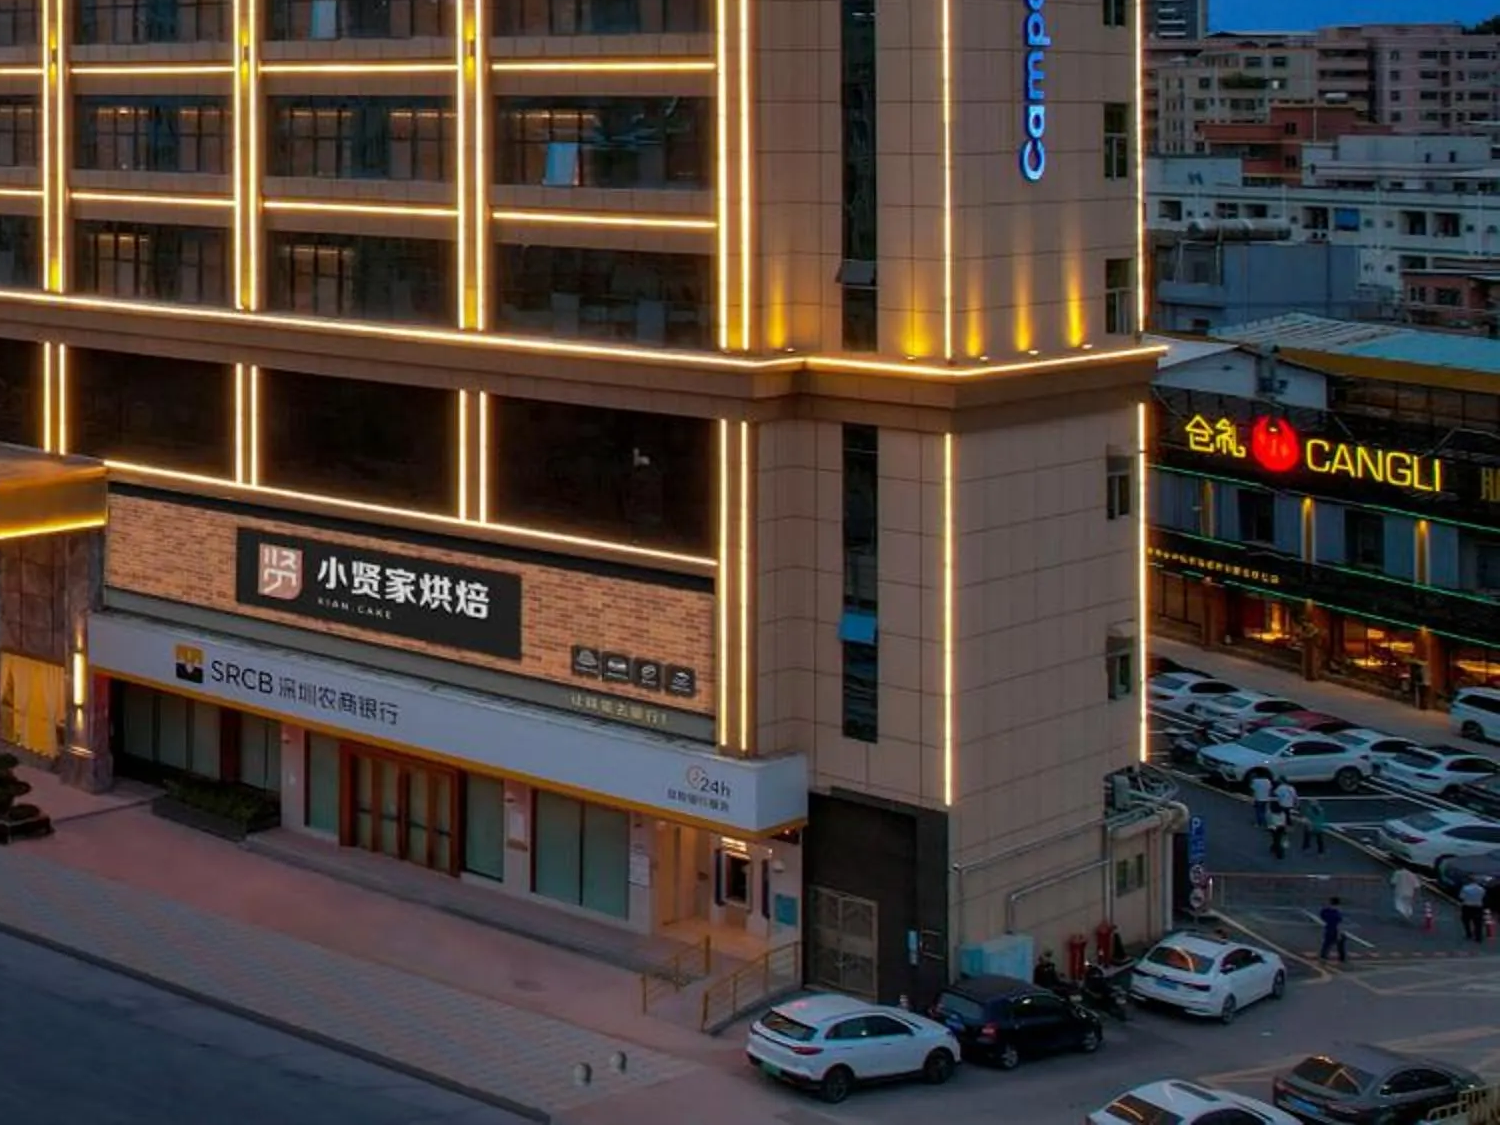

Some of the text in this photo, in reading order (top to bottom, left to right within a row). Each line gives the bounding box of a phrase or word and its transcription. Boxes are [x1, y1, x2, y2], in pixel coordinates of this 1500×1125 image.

[1305, 438, 1442, 493] CANGLI
[316, 556, 491, 620] 小贤家烘焙
[210, 659, 400, 725] SRCB 深圳农商银行
[699, 776, 731, 799] 24h
